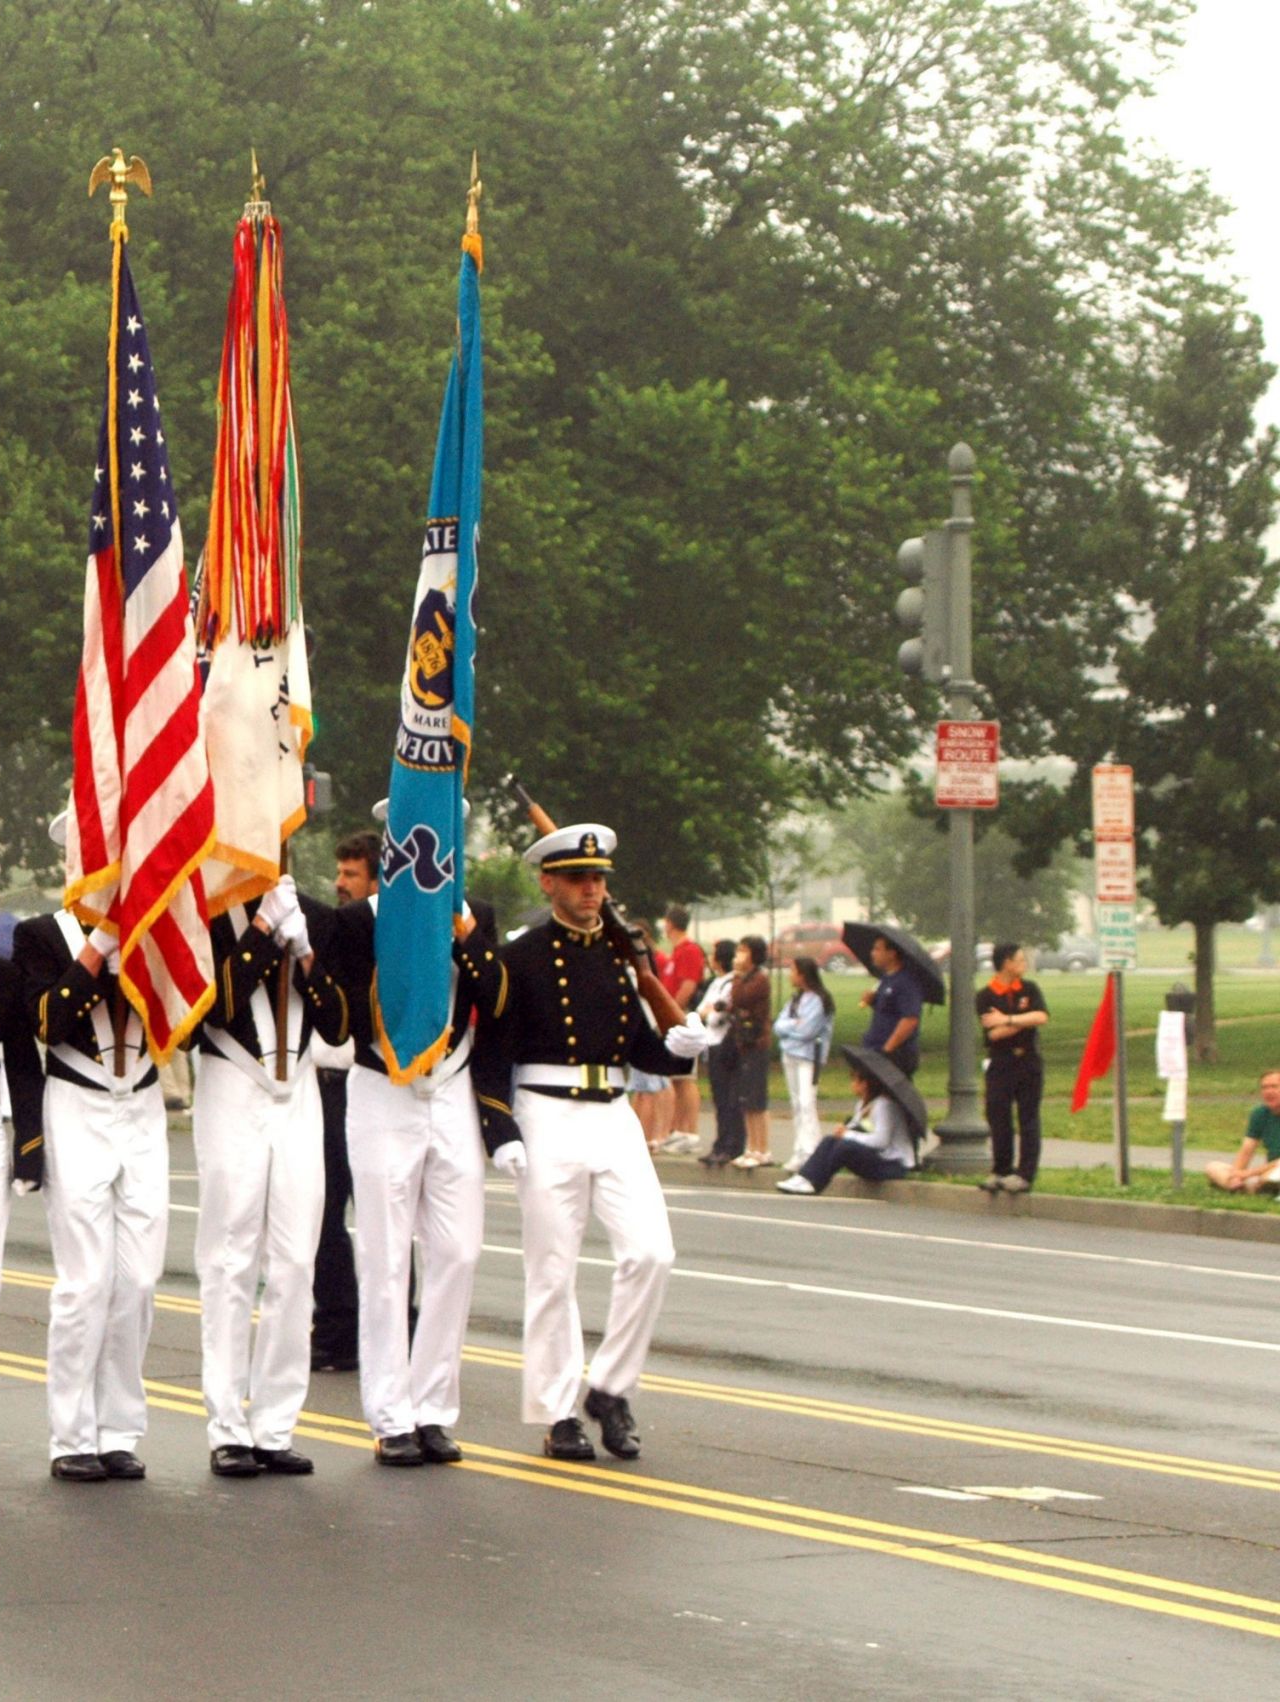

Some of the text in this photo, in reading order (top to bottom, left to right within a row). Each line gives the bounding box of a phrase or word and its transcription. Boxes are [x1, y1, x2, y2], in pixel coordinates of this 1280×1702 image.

[413, 712, 448, 729] MARE
[947, 725, 987, 738] SNOW
[942, 748, 990, 761] ROUTE
